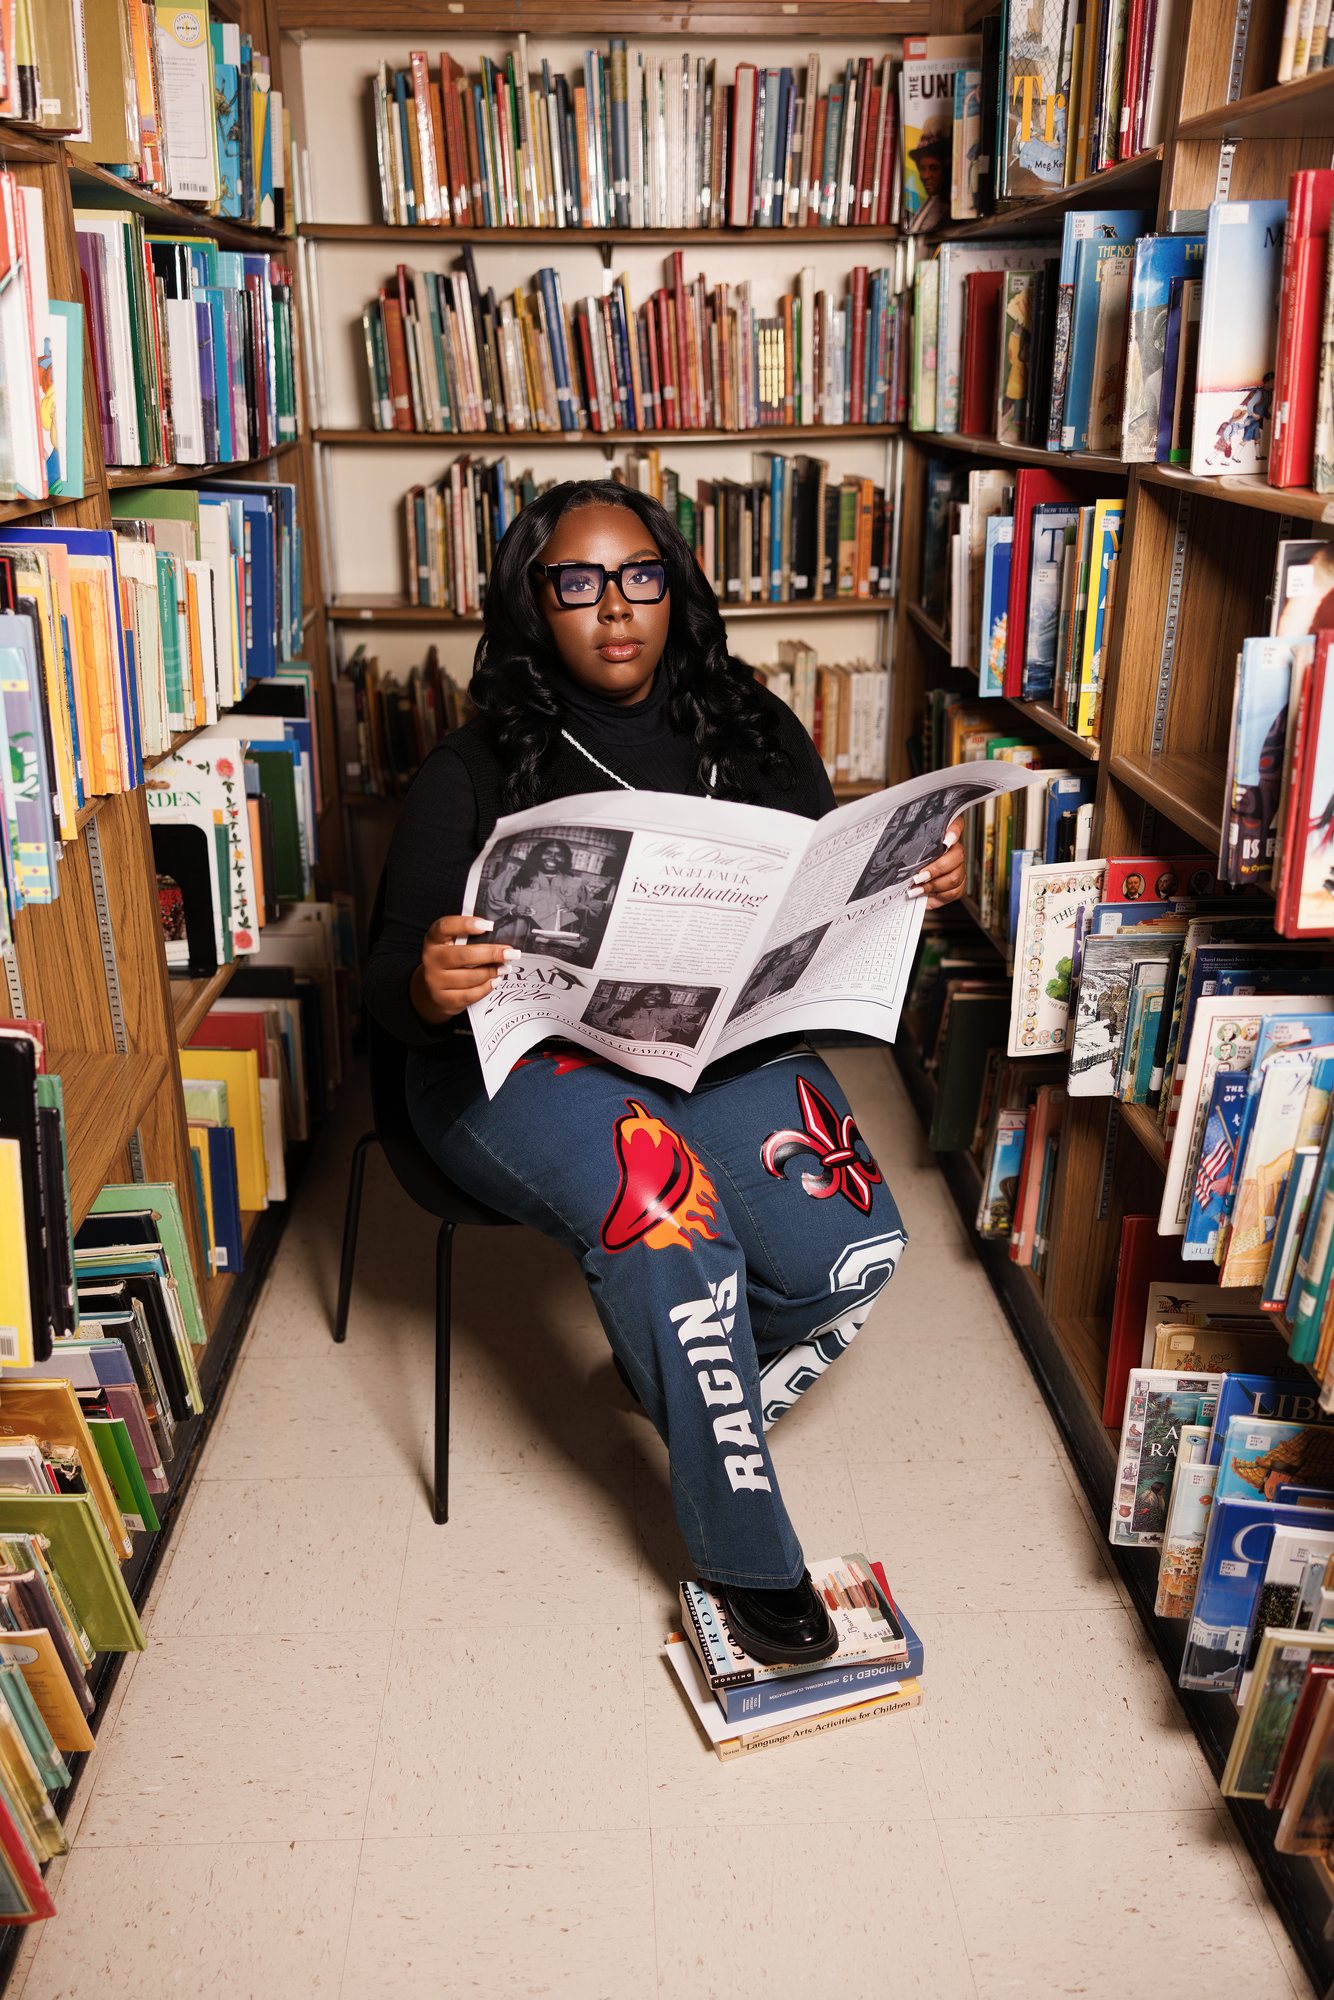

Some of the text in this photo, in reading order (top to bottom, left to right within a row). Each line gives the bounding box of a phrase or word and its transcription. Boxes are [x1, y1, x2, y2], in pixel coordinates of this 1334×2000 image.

[909, 76, 919, 100] THE
[1034, 160, 1051, 171] Meg
[1098, 245, 1117, 258] THE
[642, 842, 687, 858] She
[686, 846, 735, 866] Did
[660, 865, 752, 886] ANGEL FAULK
[632, 876, 769, 908] is graduating!
[1051, 906, 1076, 924] THE
[487, 1011, 534, 1051] UNIVERSITY
[618, 1044, 683, 1060] LAFAYETTE
[694, 1590, 726, 1662] FROM
[714, 1673, 752, 1684] HORNING
[769, 1661, 912, 1700] ABRIDGED 13 DEWEY DECIMAL CLASSIFICATION
[746, 1733, 790, 1751] Language
[793, 1727, 812, 1738] Arts
[815, 1715, 857, 1732] Activities
[859, 1711, 870, 1719] for
[873, 1701, 911, 1715] Children
